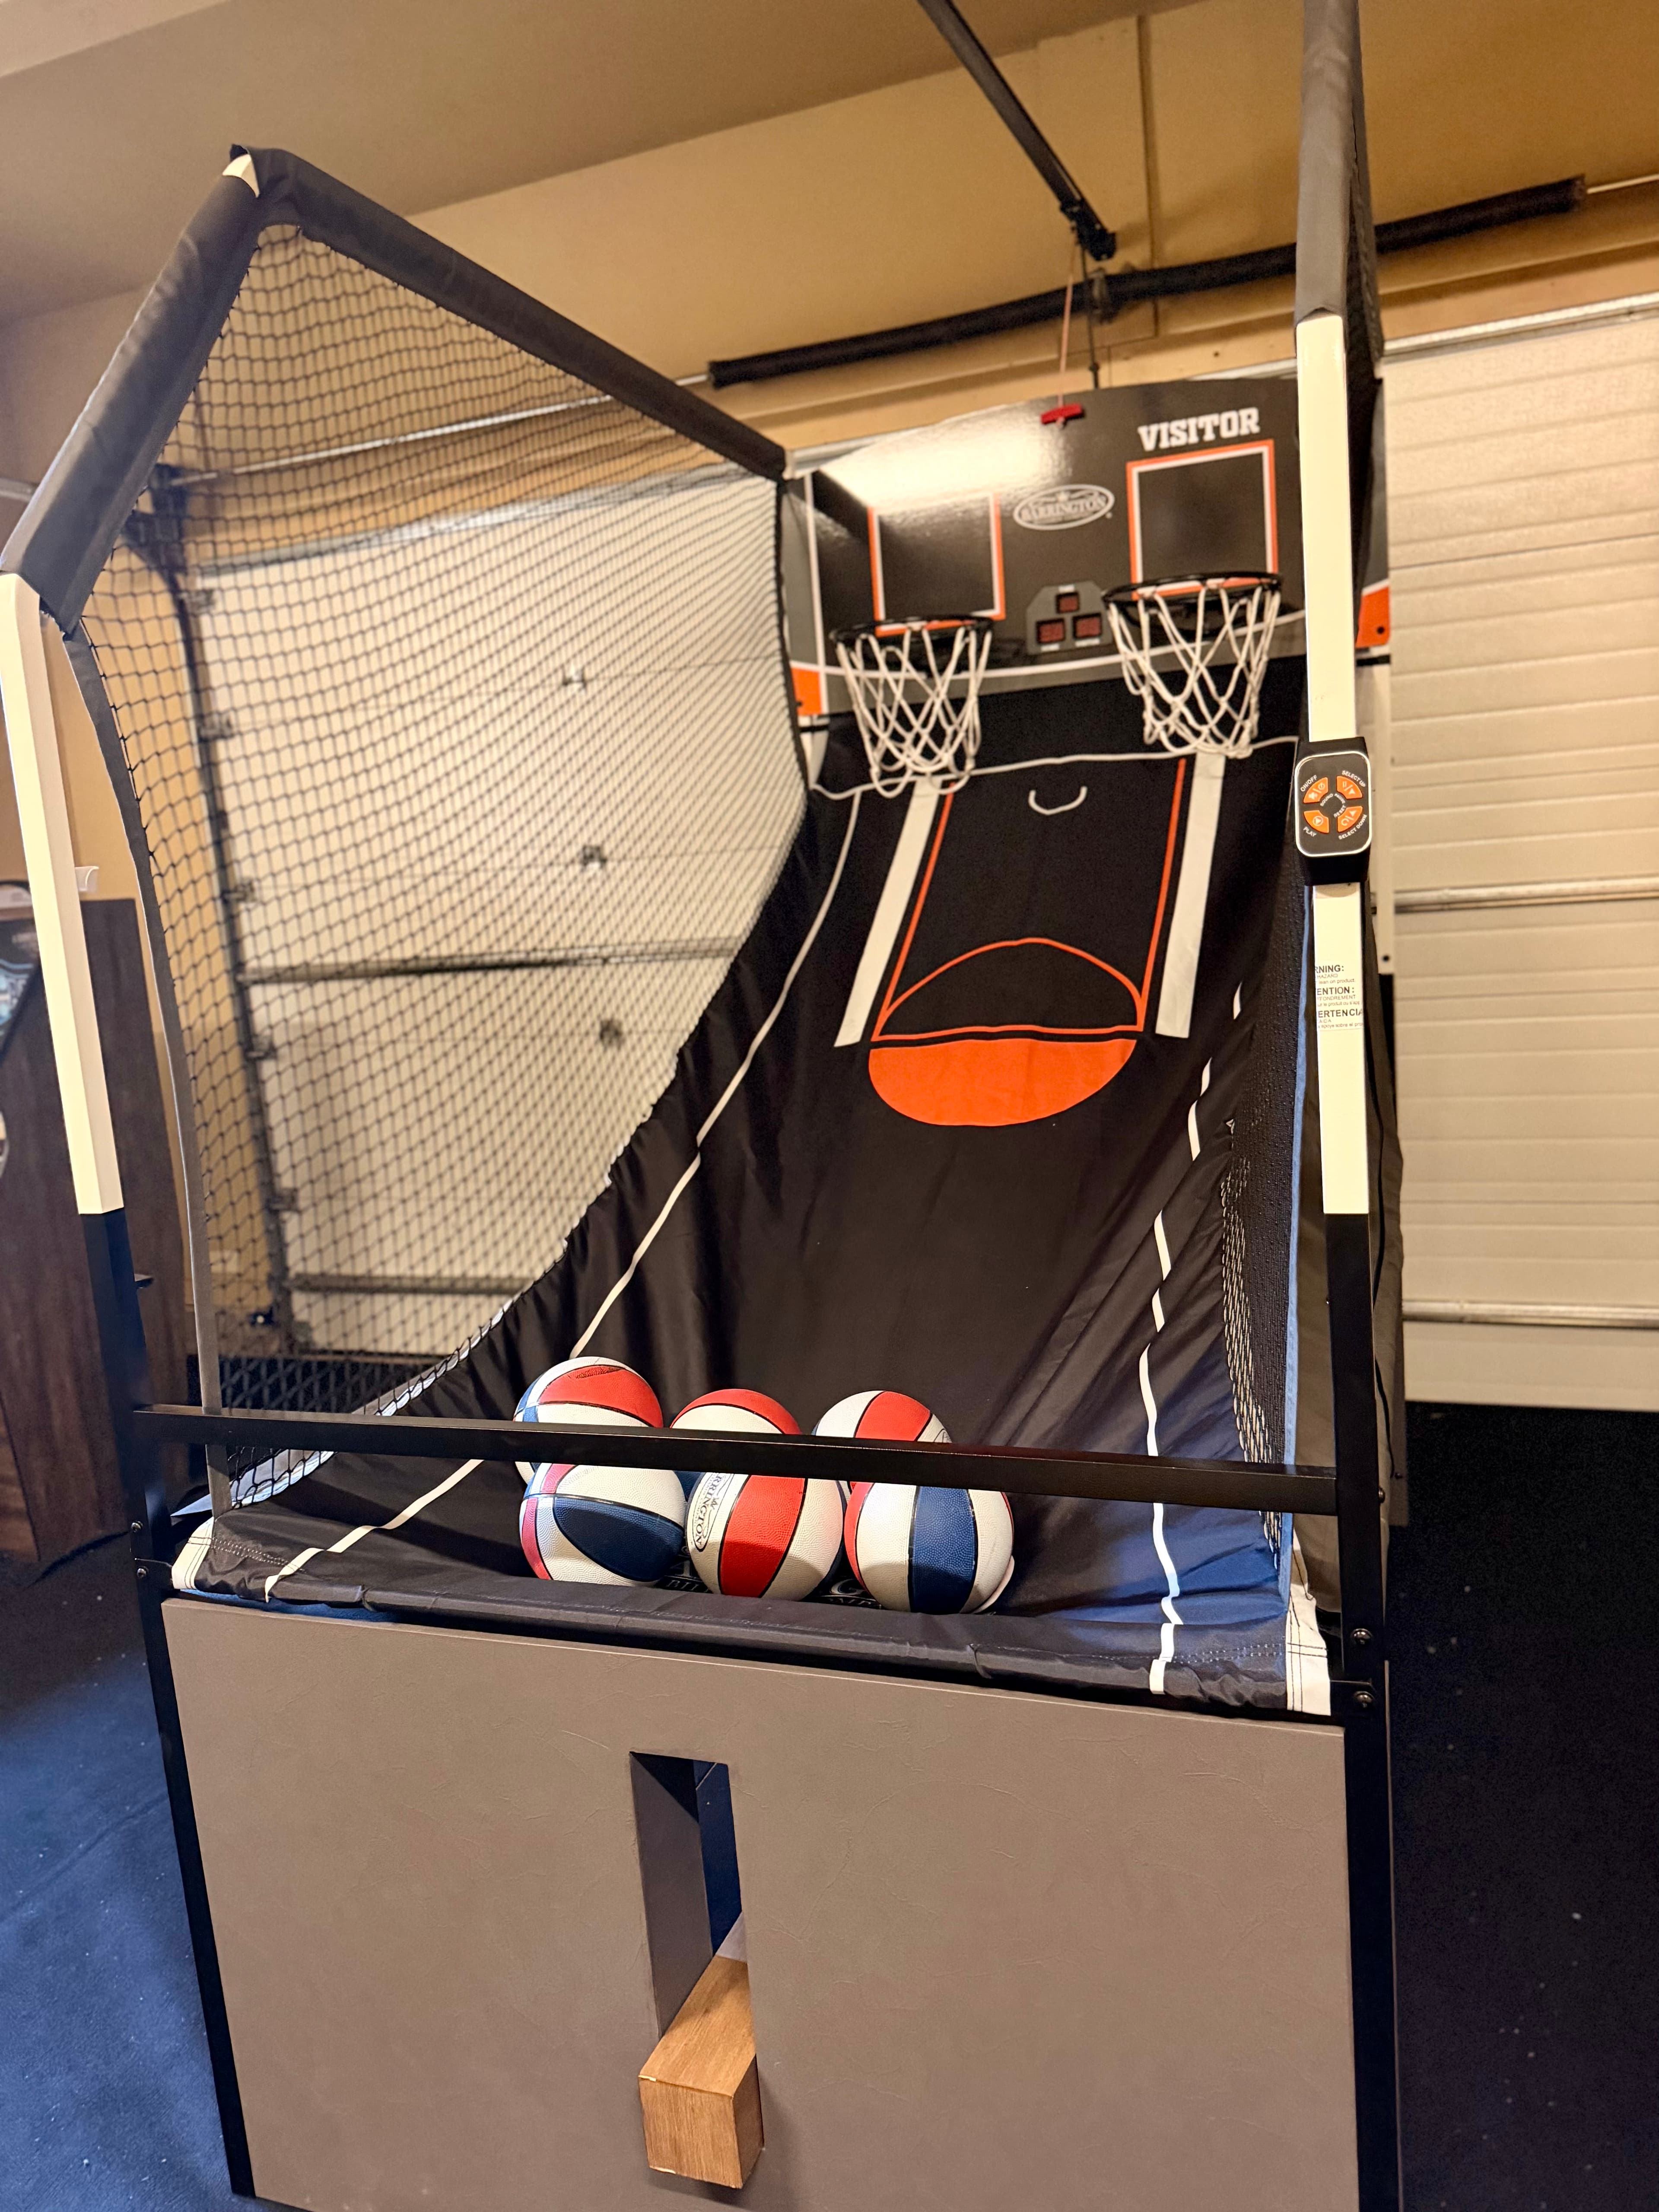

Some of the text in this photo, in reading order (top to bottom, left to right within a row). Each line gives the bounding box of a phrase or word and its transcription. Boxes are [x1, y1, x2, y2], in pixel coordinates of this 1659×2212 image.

[1138, 407, 1260, 451] VISITOR
[1300, 775, 1317, 792] ON/OFF
[1341, 770, 1366, 787] SELECT UP
[1320, 793, 1334, 807] SOUND
[1333, 805, 1346, 818] RESET
[1303, 826, 1316, 837] PLAY
[1338, 814, 1367, 840] SELECT DOWN
[1315, 965, 1344, 973] RNING:
[1317, 986, 1350, 995] ENTION
[1318, 1008, 1363, 1018] ERTENCIA
[696, 1473, 722, 1546] RRINGTON
